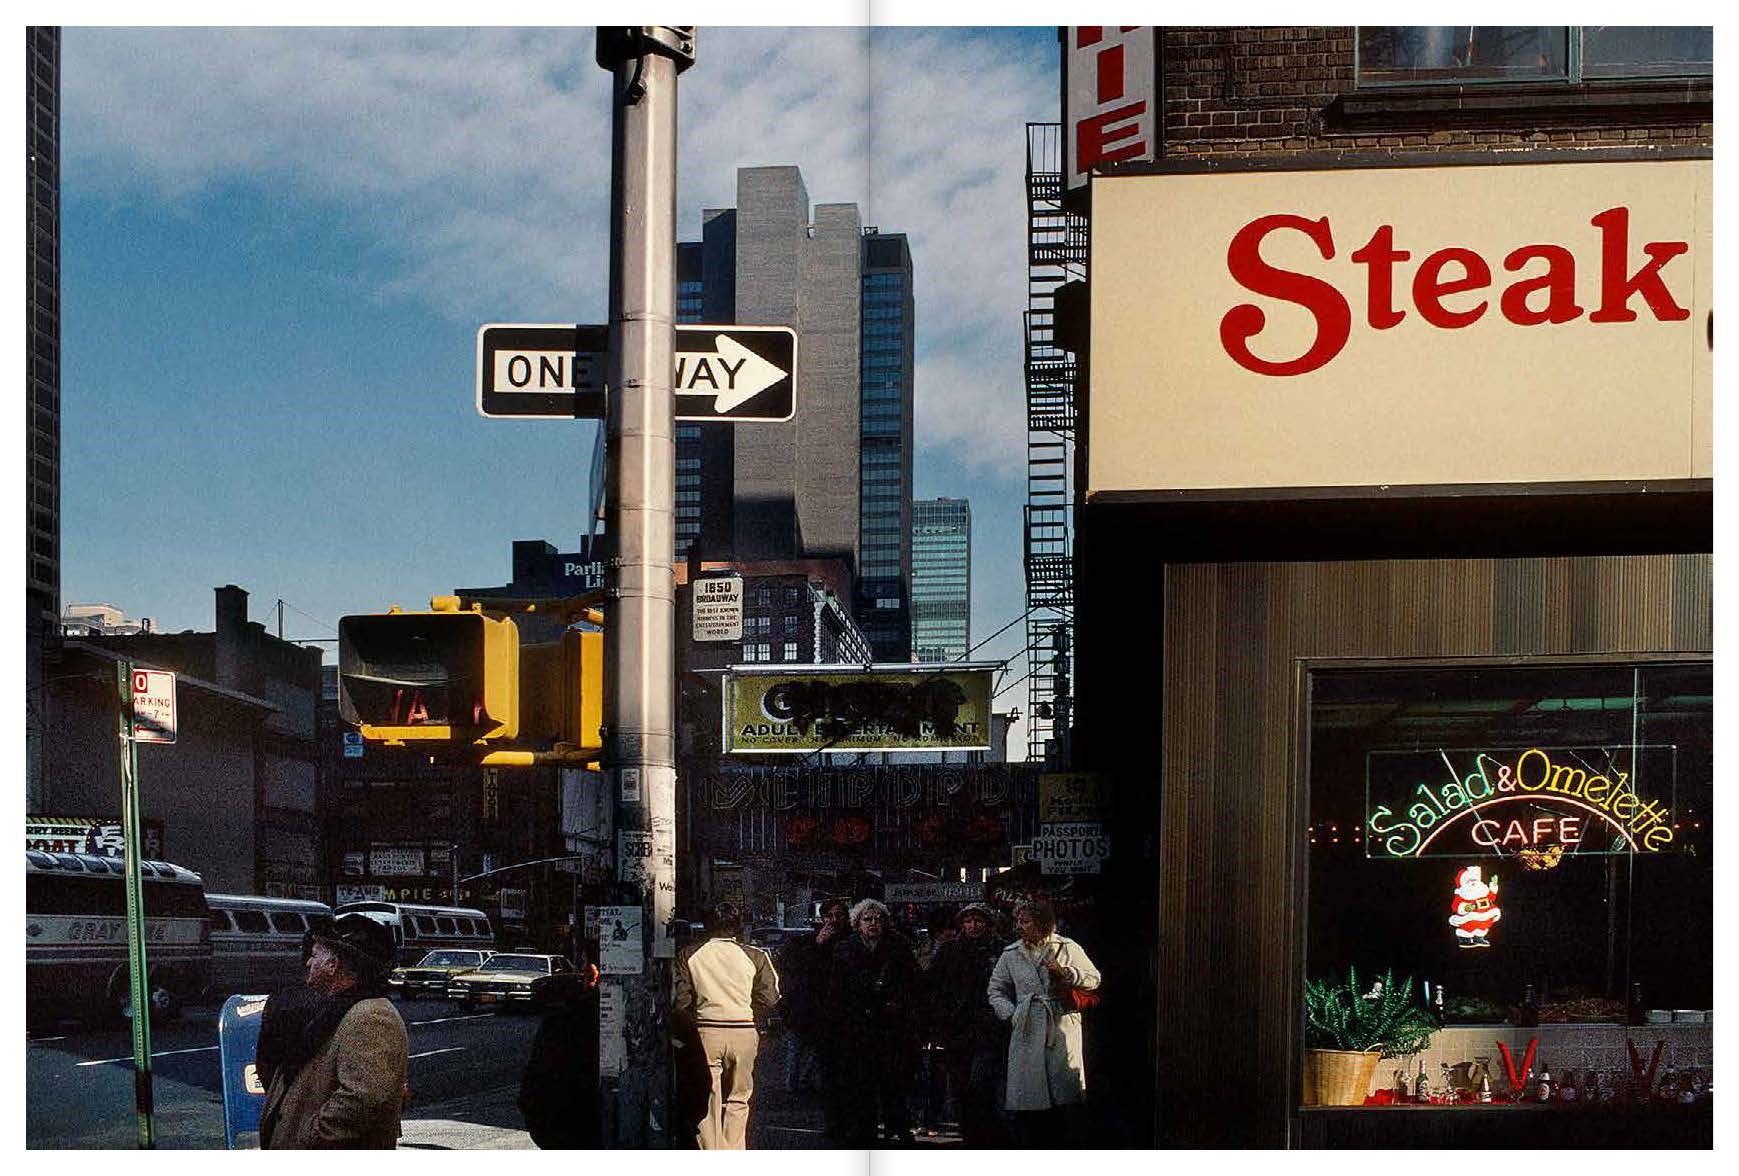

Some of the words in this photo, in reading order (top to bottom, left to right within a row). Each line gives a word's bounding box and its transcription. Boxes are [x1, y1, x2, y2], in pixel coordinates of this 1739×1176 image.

[1219, 207, 1690, 376] Steak
[507, 355, 592, 388] ONE
[696, 594, 739, 603] BROADWAY
[135, 674, 147, 691] O
[134, 697, 170, 708] ARKING
[741, 724, 805, 736] ADUL
[741, 736, 757, 744] NO
[763, 736, 799, 744] COVER
[1369, 753, 1495, 856] Salad
[1497, 765, 1518, 792] &
[1516, 748, 1673, 851] Omelette
[1042, 826, 1101, 837] PASSPORT
[1471, 817, 1582, 846] CAFE
[26, 839, 79, 853] OAT
[1033, 838, 1107, 858] PHOTOS
[384, 888, 432, 901] MPIE
